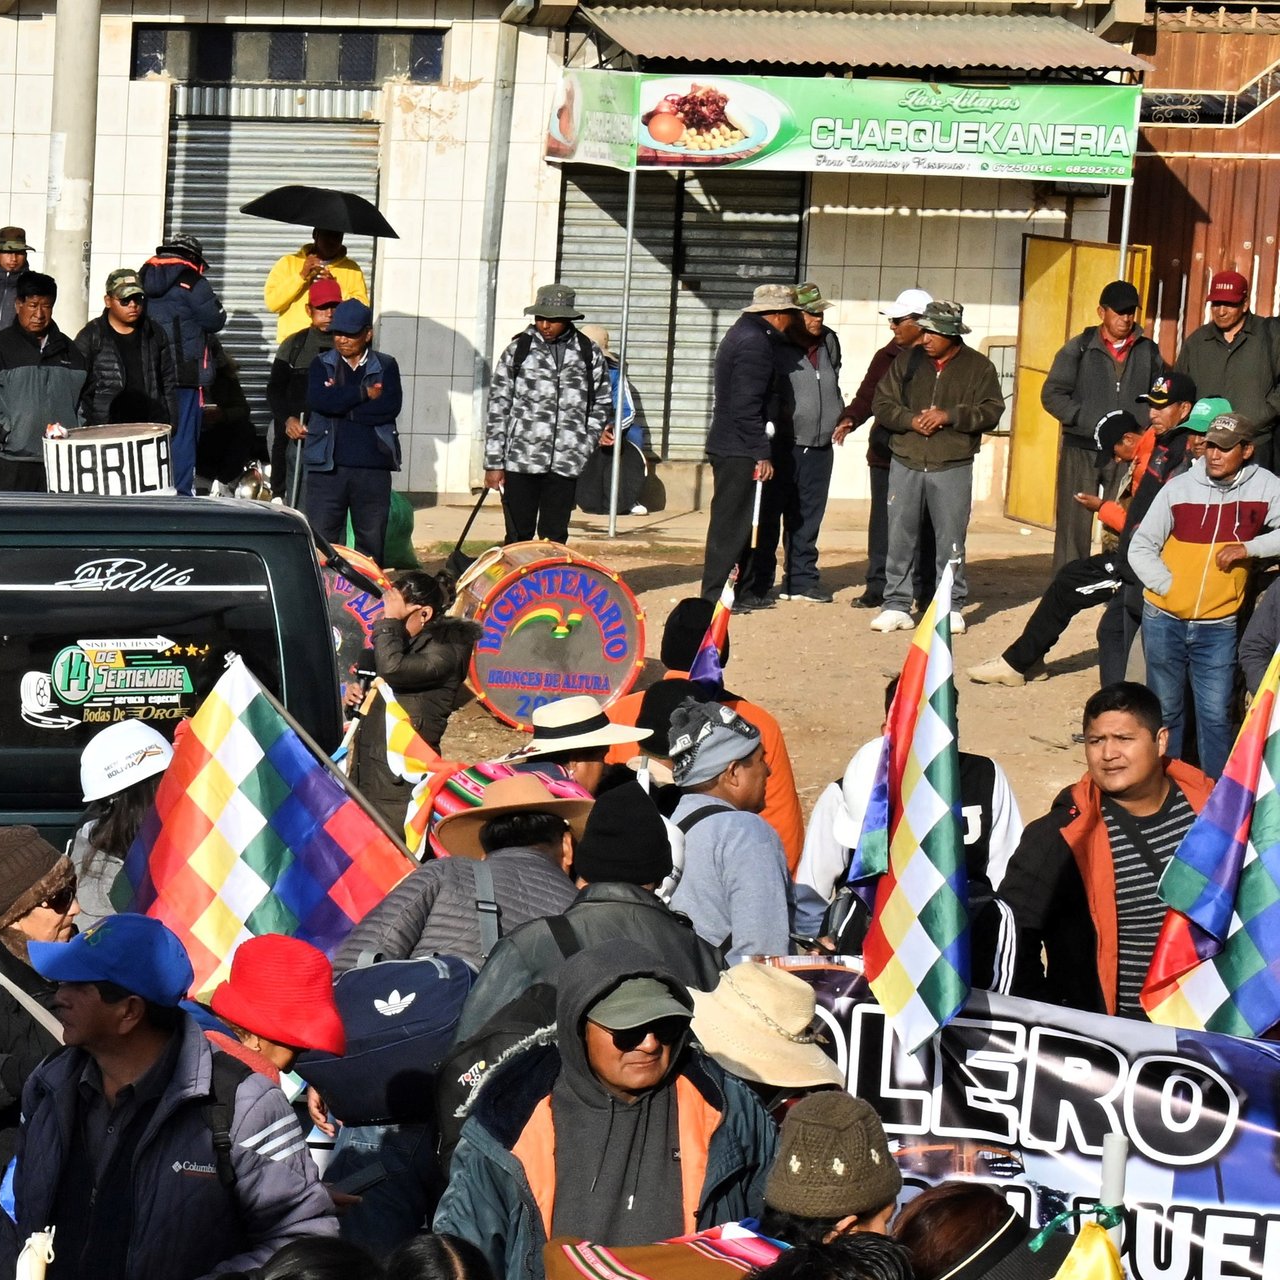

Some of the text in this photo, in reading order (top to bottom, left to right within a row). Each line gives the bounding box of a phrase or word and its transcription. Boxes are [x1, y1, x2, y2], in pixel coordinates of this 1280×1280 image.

[810, 118, 1132, 157] CHARQUEKANERIA
[1065, 164, 1126, 175] 68292178
[477, 566, 629, 663] BICENTENARIO
[95, 651, 117, 664] DE
[60, 650, 90, 692] 14
[487, 668, 611, 694] BRONCES DE ALTURA
[83, 708, 111, 723] Bodas
[113, 707, 126, 721] De
